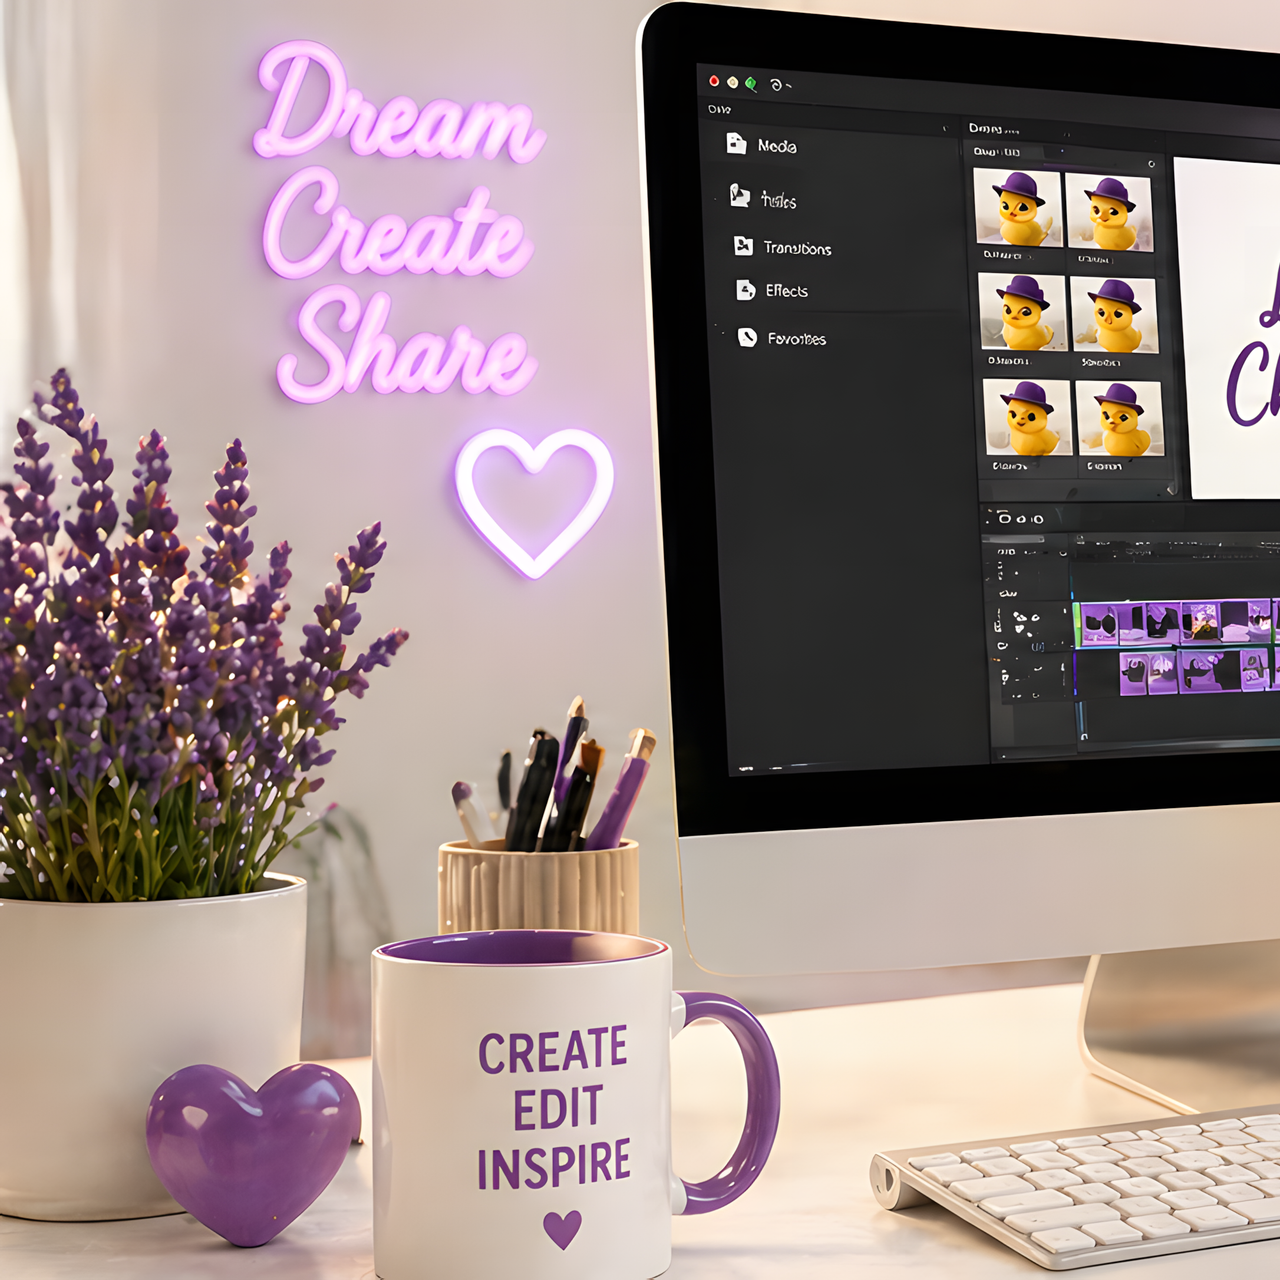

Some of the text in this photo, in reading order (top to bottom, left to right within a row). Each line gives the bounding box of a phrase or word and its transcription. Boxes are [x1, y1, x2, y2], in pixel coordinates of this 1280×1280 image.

[253, 40, 547, 164] Dream
[263, 165, 535, 280] Create
[766, 283, 809, 298] Effects
[276, 284, 539, 404] Share
[478, 1024, 628, 1075] CREATE
[514, 1084, 604, 1131] EDIT
[478, 1137, 631, 1190] INSPIRE
